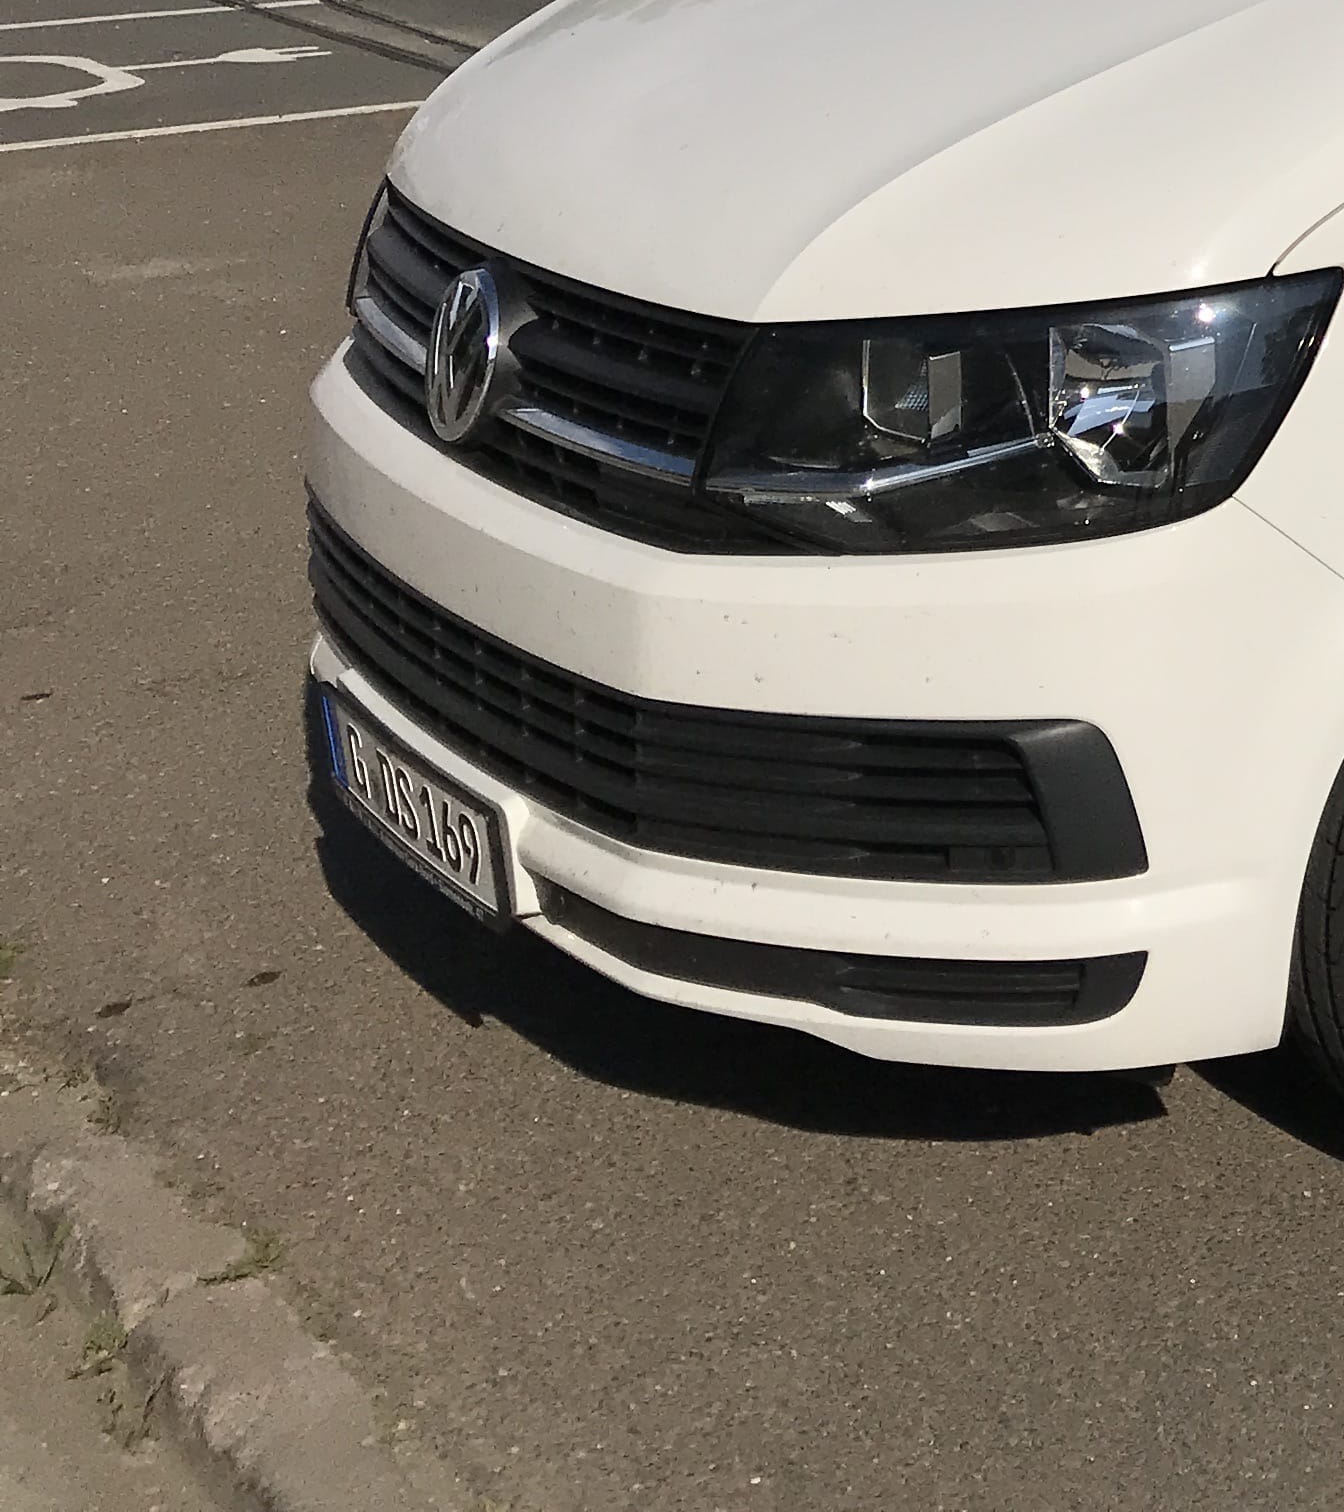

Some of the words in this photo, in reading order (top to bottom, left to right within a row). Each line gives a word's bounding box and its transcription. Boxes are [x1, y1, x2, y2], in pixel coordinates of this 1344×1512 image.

[346, 722, 372, 800] G
[375, 747, 422, 841] DS
[418, 784, 482, 887] 169
